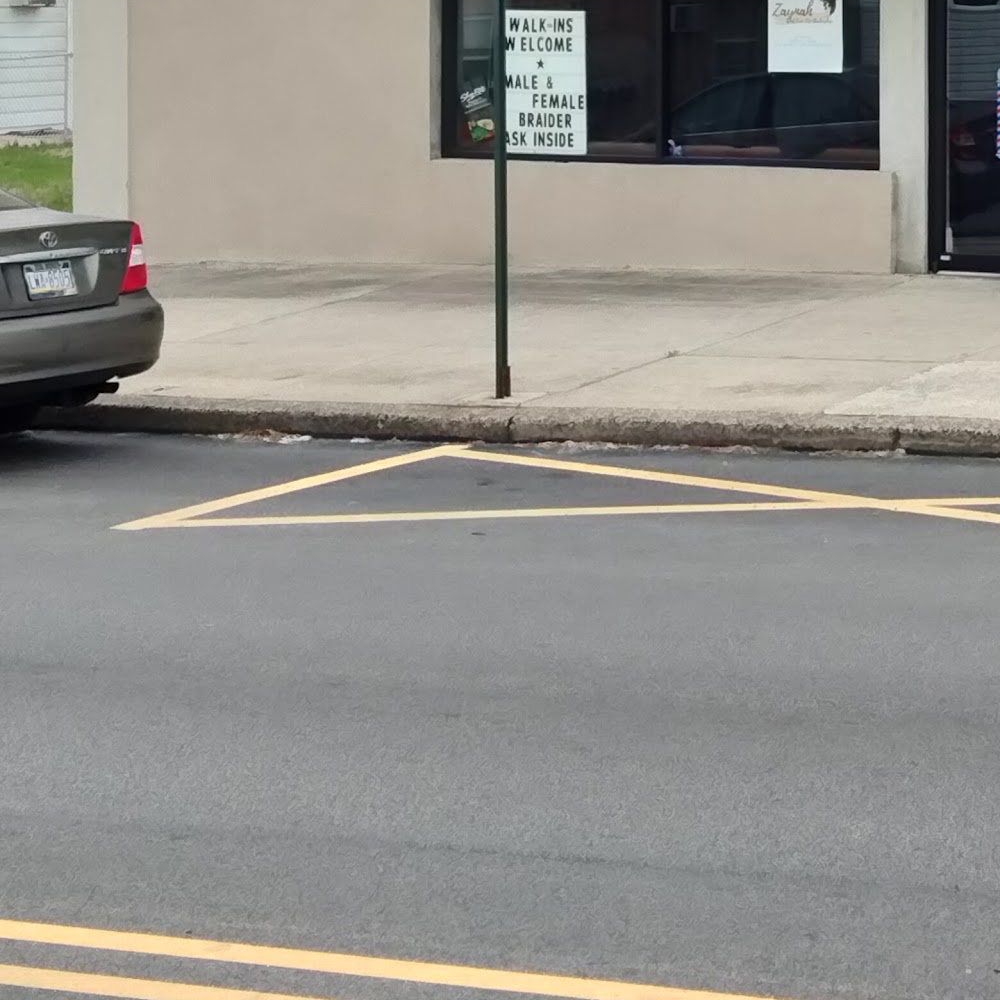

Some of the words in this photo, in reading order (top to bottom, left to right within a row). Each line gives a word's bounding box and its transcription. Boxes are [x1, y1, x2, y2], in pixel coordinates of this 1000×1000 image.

[509, 17, 574, 33] WALK-INS
[505, 36, 573, 52] WELCOME
[546, 76, 554, 90] &
[532, 93, 585, 110] FEMALE
[519, 112, 573, 129] BRAIDER
[533, 132, 575, 148] INSIDE
